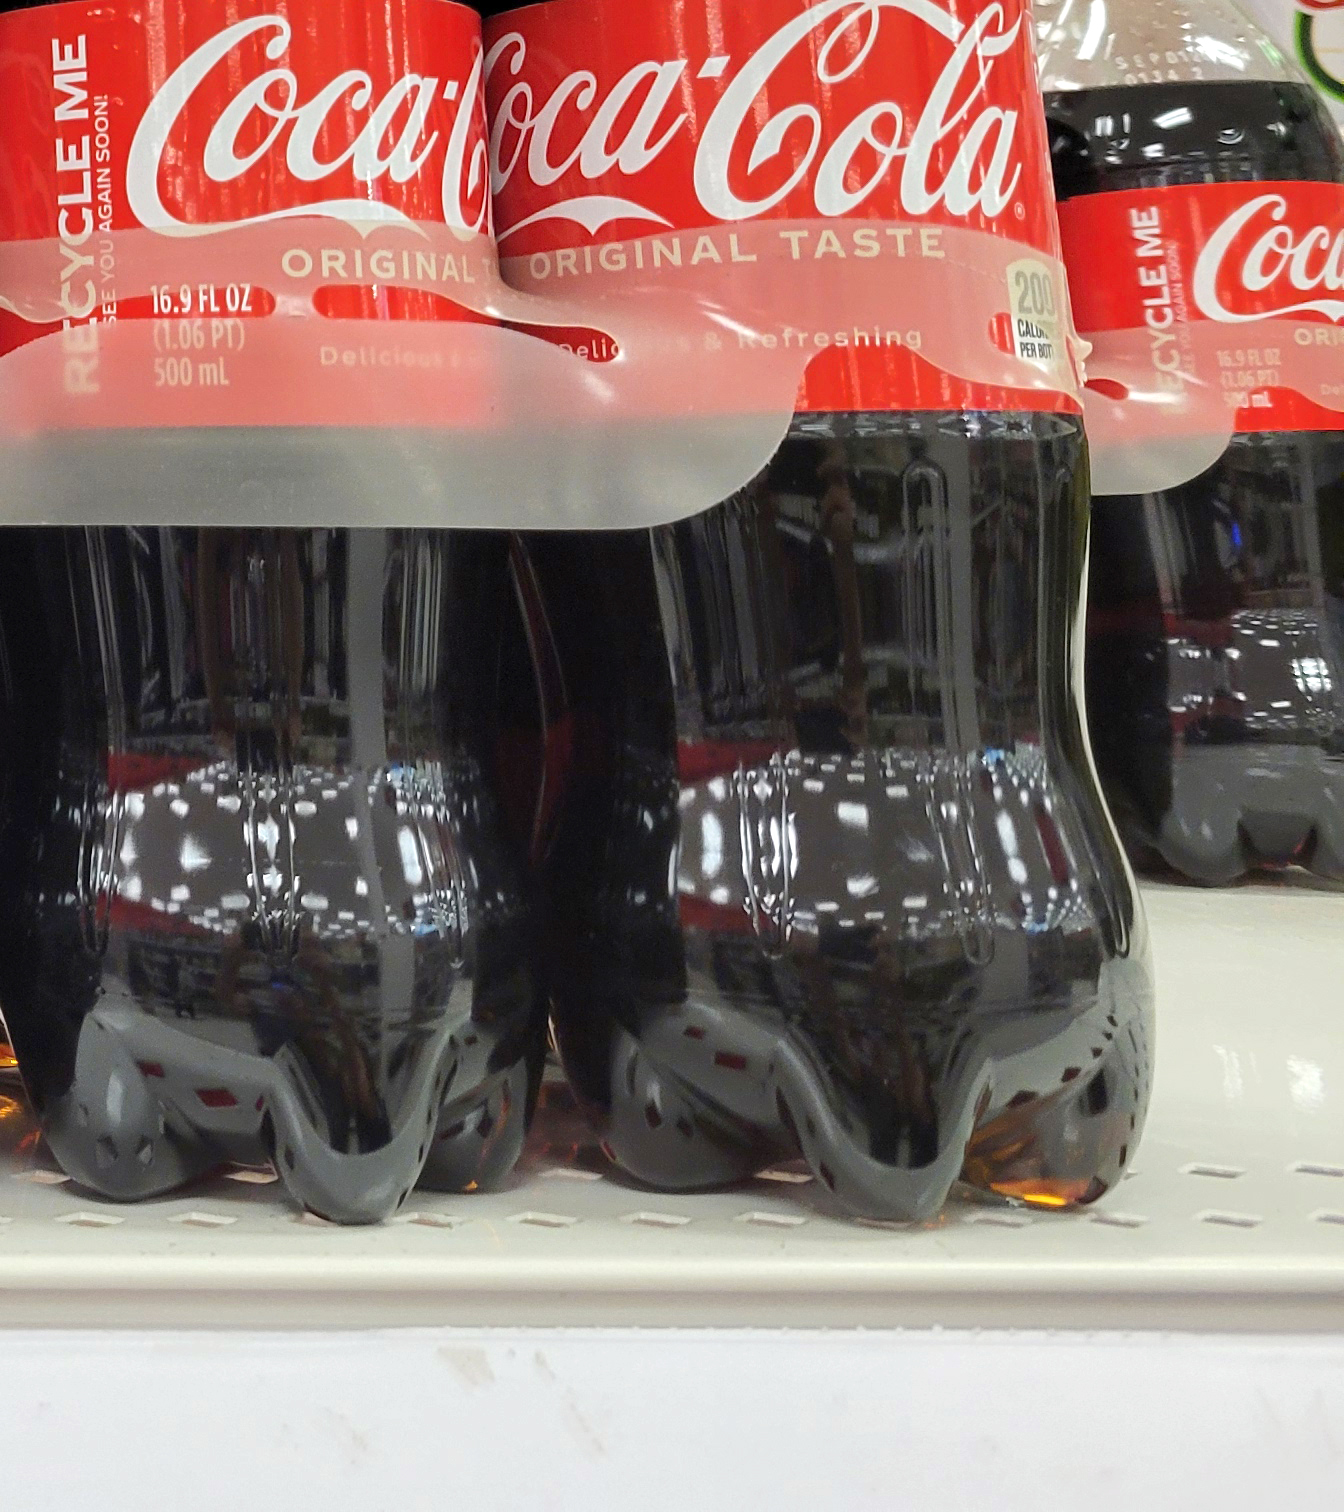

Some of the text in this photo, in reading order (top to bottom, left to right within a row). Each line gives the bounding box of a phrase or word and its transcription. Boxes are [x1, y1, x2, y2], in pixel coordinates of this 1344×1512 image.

[51, 33, 90, 122] ME
[93, 95, 109, 164] SOON!
[126, 15, 494, 240] Coca-C
[95, 168, 113, 232] AGAIN
[529, 233, 757, 280] ORIGINAL
[780, 227, 946, 261] TASTE
[1130, 206, 1165, 257] ME
[99, 240, 115, 284] YOU
[281, 249, 476, 284] ORIGINAL
[150, 282, 253, 314] 16.9 FL OZ
[1014, 269, 1056, 317] 200
[153, 319, 245, 353] (1.06 PT)
[737, 326, 923, 351] Refreshing
[1020, 342, 1036, 360] PER
[154, 356, 230, 387] 500 mL
